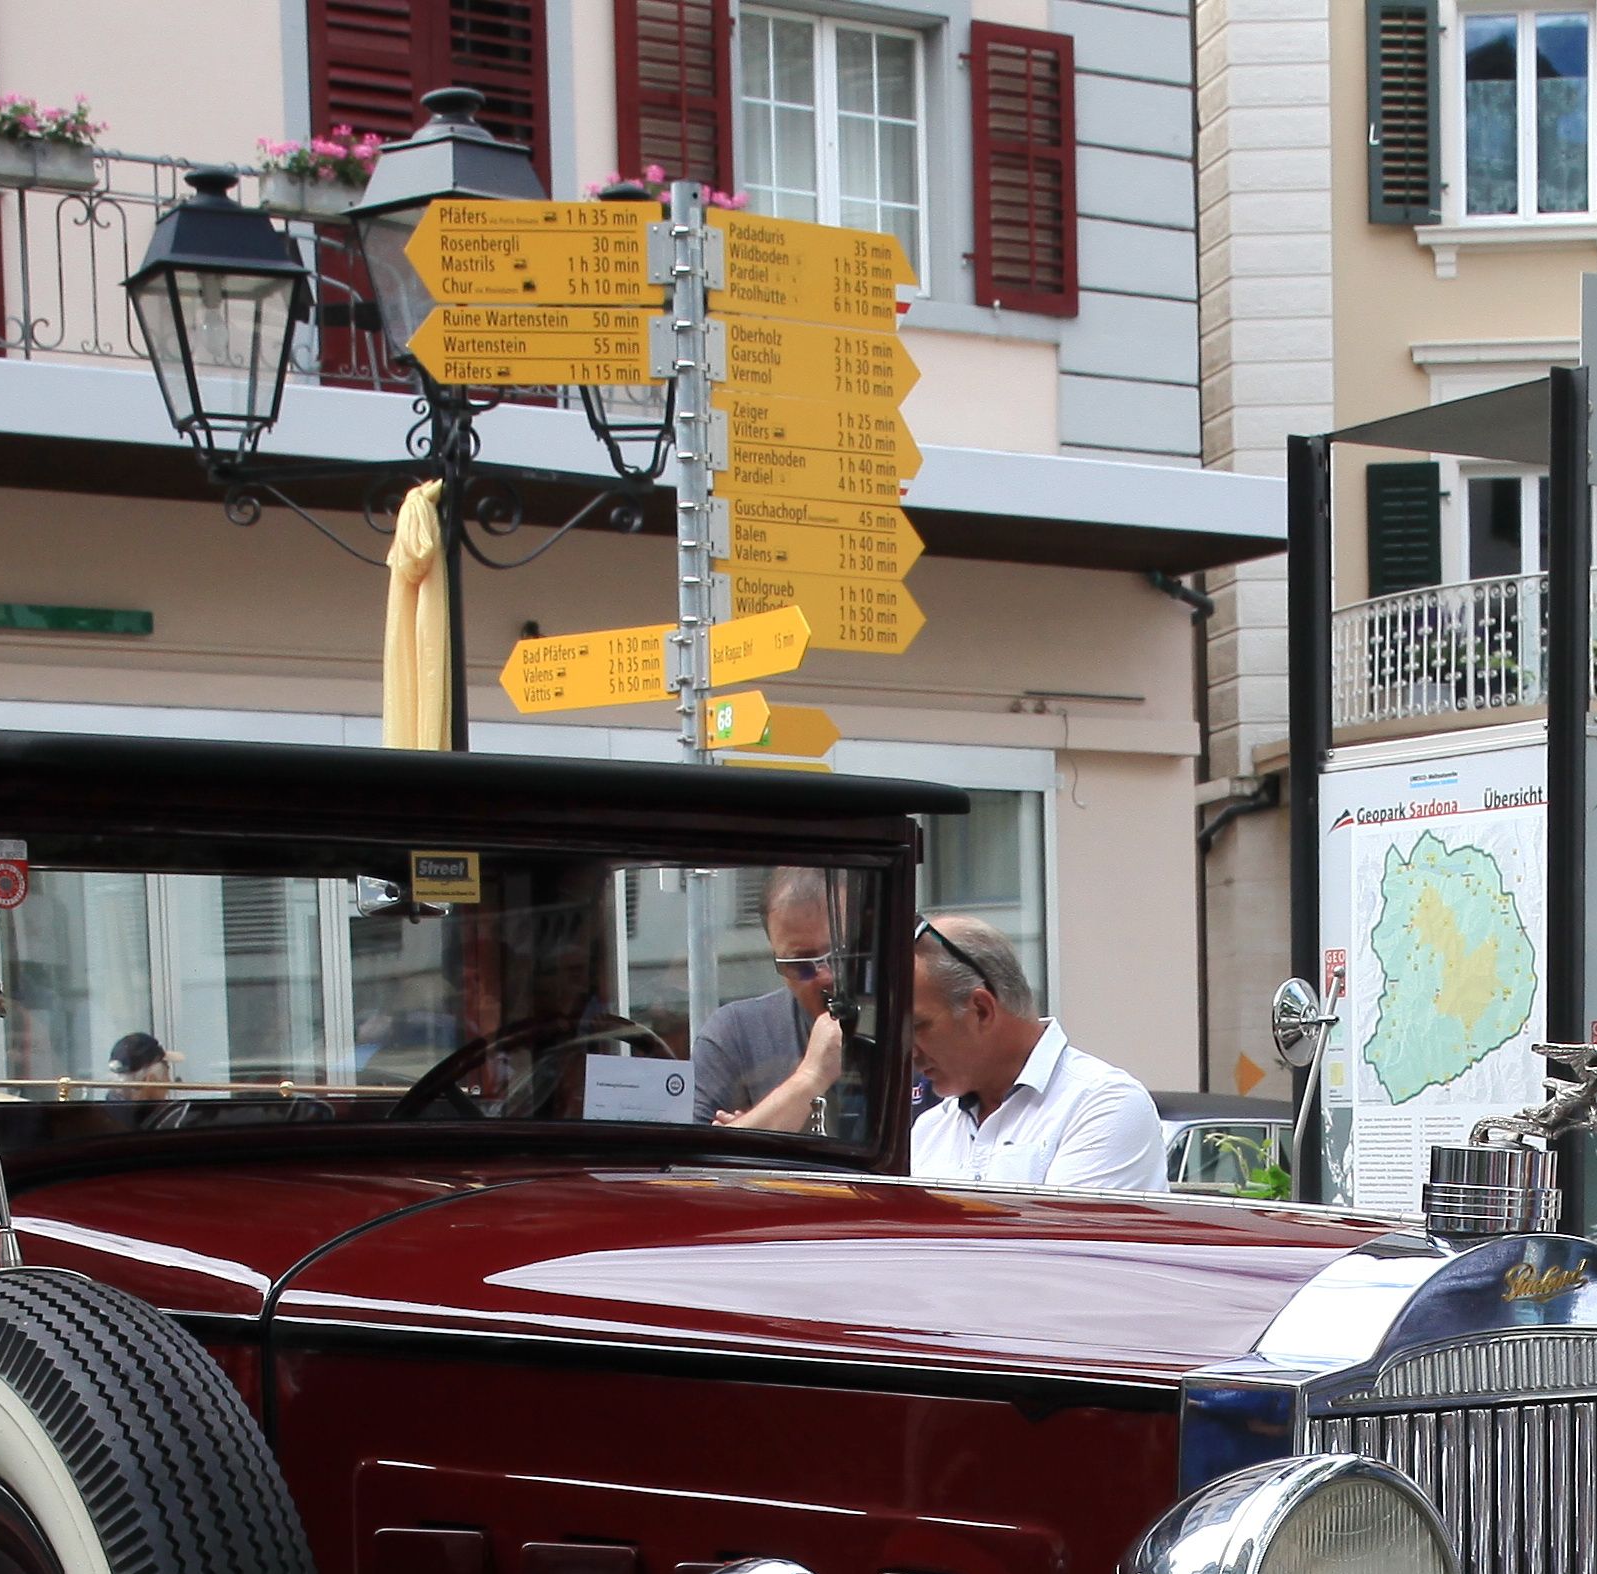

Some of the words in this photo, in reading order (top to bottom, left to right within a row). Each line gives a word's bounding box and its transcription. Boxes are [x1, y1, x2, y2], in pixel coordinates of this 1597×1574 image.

[440, 207, 487, 224] Pfäfers
[579, 209, 586, 224] h
[592, 209, 607, 224] 35
[613, 210, 637, 225] min
[441, 235, 519, 255] Rosenbergli
[593, 237, 608, 252] 30
[614, 237, 638, 252] min
[730, 223, 785, 245] Padaduris
[855, 241, 866, 257] 35
[871, 244, 891, 260] min
[442, 256, 495, 272] Mastrils
[581, 257, 588, 272] h
[594, 258, 609, 272] 30
[615, 258, 639, 273] min
[730, 243, 788, 265] Wildboden
[844, 259, 851, 274] h
[855, 261, 867, 276] 35
[872, 263, 892, 279] min
[443, 279, 472, 293] Chur
[569, 279, 576, 294] 5
[582, 279, 589, 294] h
[596, 280, 610, 295] 10
[616, 280, 640, 295] min
[730, 264, 768, 283] Pardiel
[844, 279, 851, 293] h
[855, 280, 867, 296] 45
[872, 283, 892, 298] min
[443, 311, 480, 326] Ruine
[486, 311, 568, 327] Wartenstein
[593, 312, 609, 327] 50
[614, 313, 639, 328] min
[844, 299, 851, 313] h
[855, 300, 868, 316] 10
[872, 302, 892, 318] min
[444, 337, 526, 353] Wartenstein
[594, 338, 610, 353] 55
[615, 339, 639, 354] min
[732, 325, 782, 346] Oberholz
[845, 338, 851, 353] h
[856, 341, 868, 355] 15
[872, 343, 892, 358] min
[445, 363, 492, 379] Pfäfers
[582, 364, 590, 379] h
[596, 365, 611, 380] 15
[616, 365, 640, 380] min
[845, 358, 852, 373] h
[856, 360, 869, 375] 30
[873, 362, 892, 378] min
[732, 367, 771, 384] Vermol
[846, 378, 852, 392] h
[857, 380, 870, 394] 10
[873, 382, 893, 397] min
[734, 402, 768, 422] Zeiger
[847, 413, 853, 428] h
[858, 414, 871, 430] 25
[875, 417, 895, 432] min
[848, 433, 854, 448] h
[858, 434, 872, 449] 20
[875, 436, 895, 451] min
[734, 448, 805, 468] Herrenboden
[849, 458, 854, 473] h
[858, 460, 872, 475] 40
[876, 461, 896, 476] min
[735, 467, 772, 484] Pardiel
[838, 477, 845, 491] 4
[849, 478, 855, 492] h
[860, 479, 872, 494] 15
[876, 480, 896, 495] min
[859, 512, 872, 526] 45
[876, 513, 896, 528] min
[849, 535, 855, 549] h
[860, 536, 873, 551] 40
[876, 538, 896, 554] min
[736, 545, 772, 562] Valens
[840, 554, 845, 568] 2
[850, 554, 855, 569] h
[860, 556, 873, 571] 30
[877, 557, 896, 572] min
[737, 577, 794, 599] Cholgrueb
[850, 588, 855, 602] h
[861, 588, 872, 603] 10
[877, 591, 896, 605] min
[523, 649, 540, 664] Bad
[544, 645, 576, 661] Pfäfers
[627, 638, 637, 653] 30
[642, 635, 659, 649] min
[524, 667, 553, 683] Valens
[628, 656, 638, 672] 35
[642, 655, 659, 669] min
[628, 676, 639, 691] 50
[642, 674, 660, 689] min
[717, 706, 732, 732] 68
[1357, 803, 1405, 825] Geopark
[1410, 799, 1457, 818] Sardona
[1484, 786, 1542, 809] Übersicht
[1326, 951, 1345, 963] GEO
